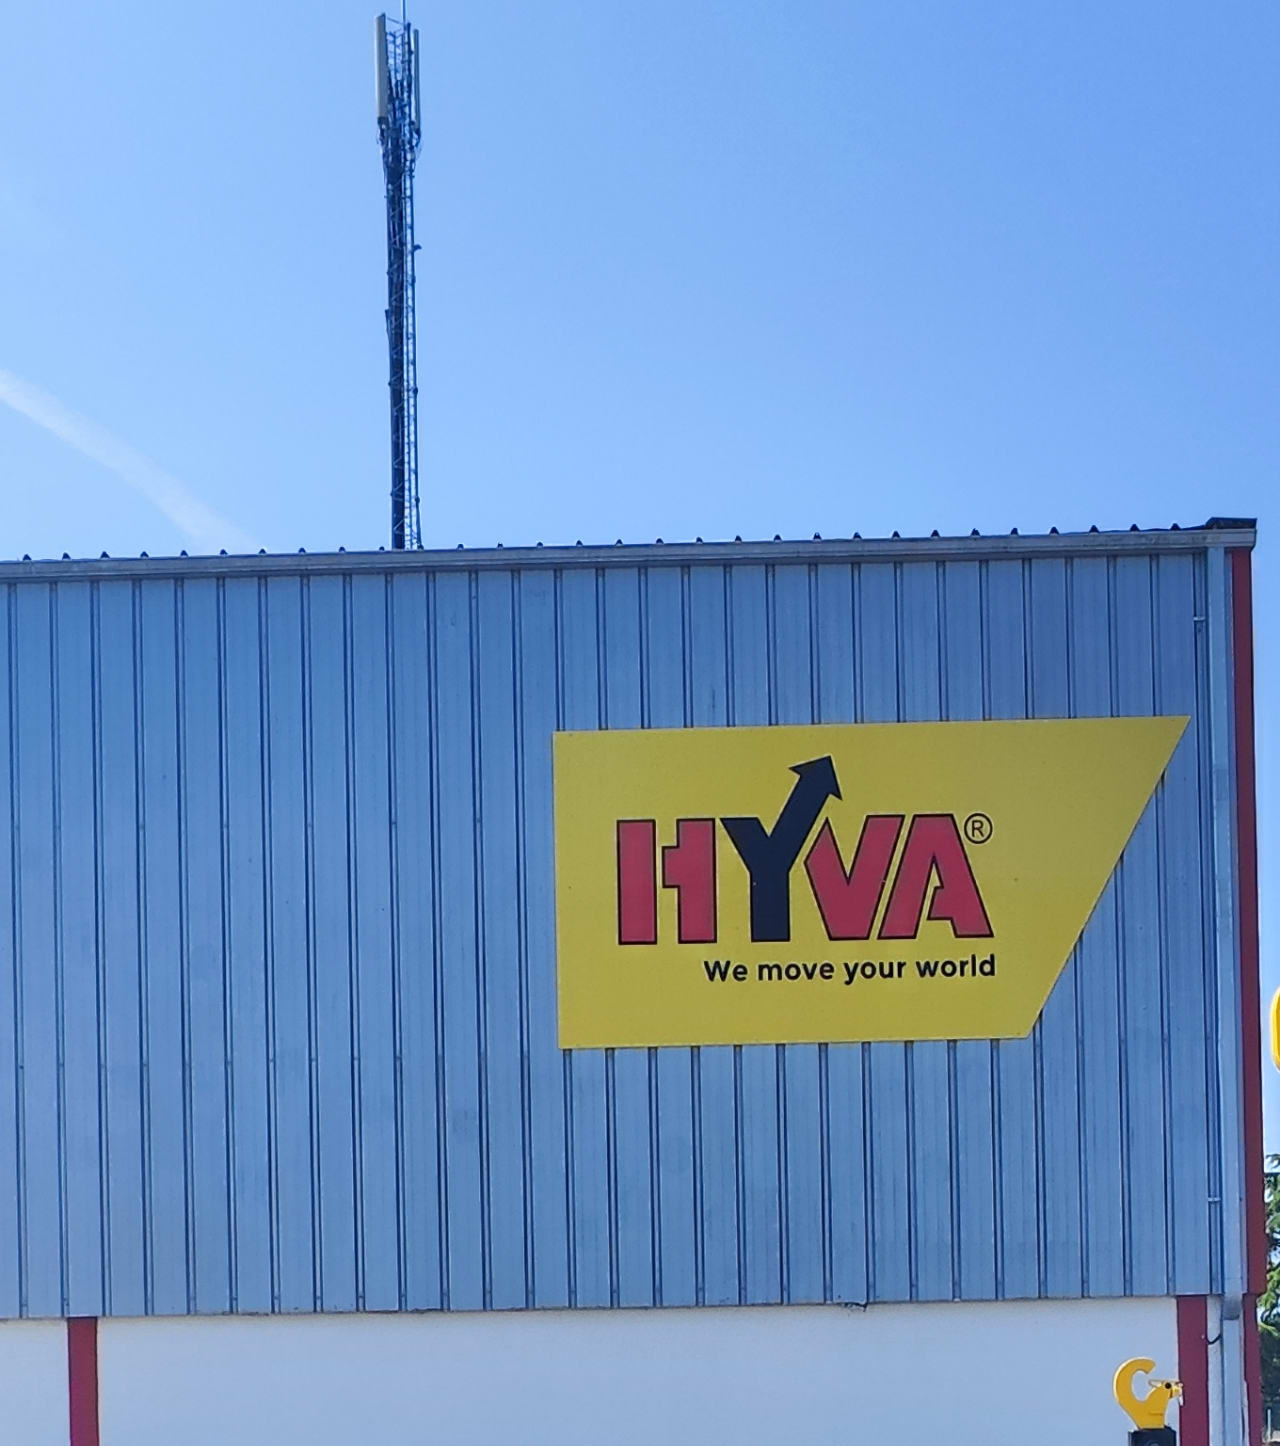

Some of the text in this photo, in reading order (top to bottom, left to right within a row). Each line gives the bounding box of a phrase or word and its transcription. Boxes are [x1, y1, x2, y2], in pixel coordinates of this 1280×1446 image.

[616, 755, 994, 945] HYVA
[704, 953, 997, 985] We move your world
